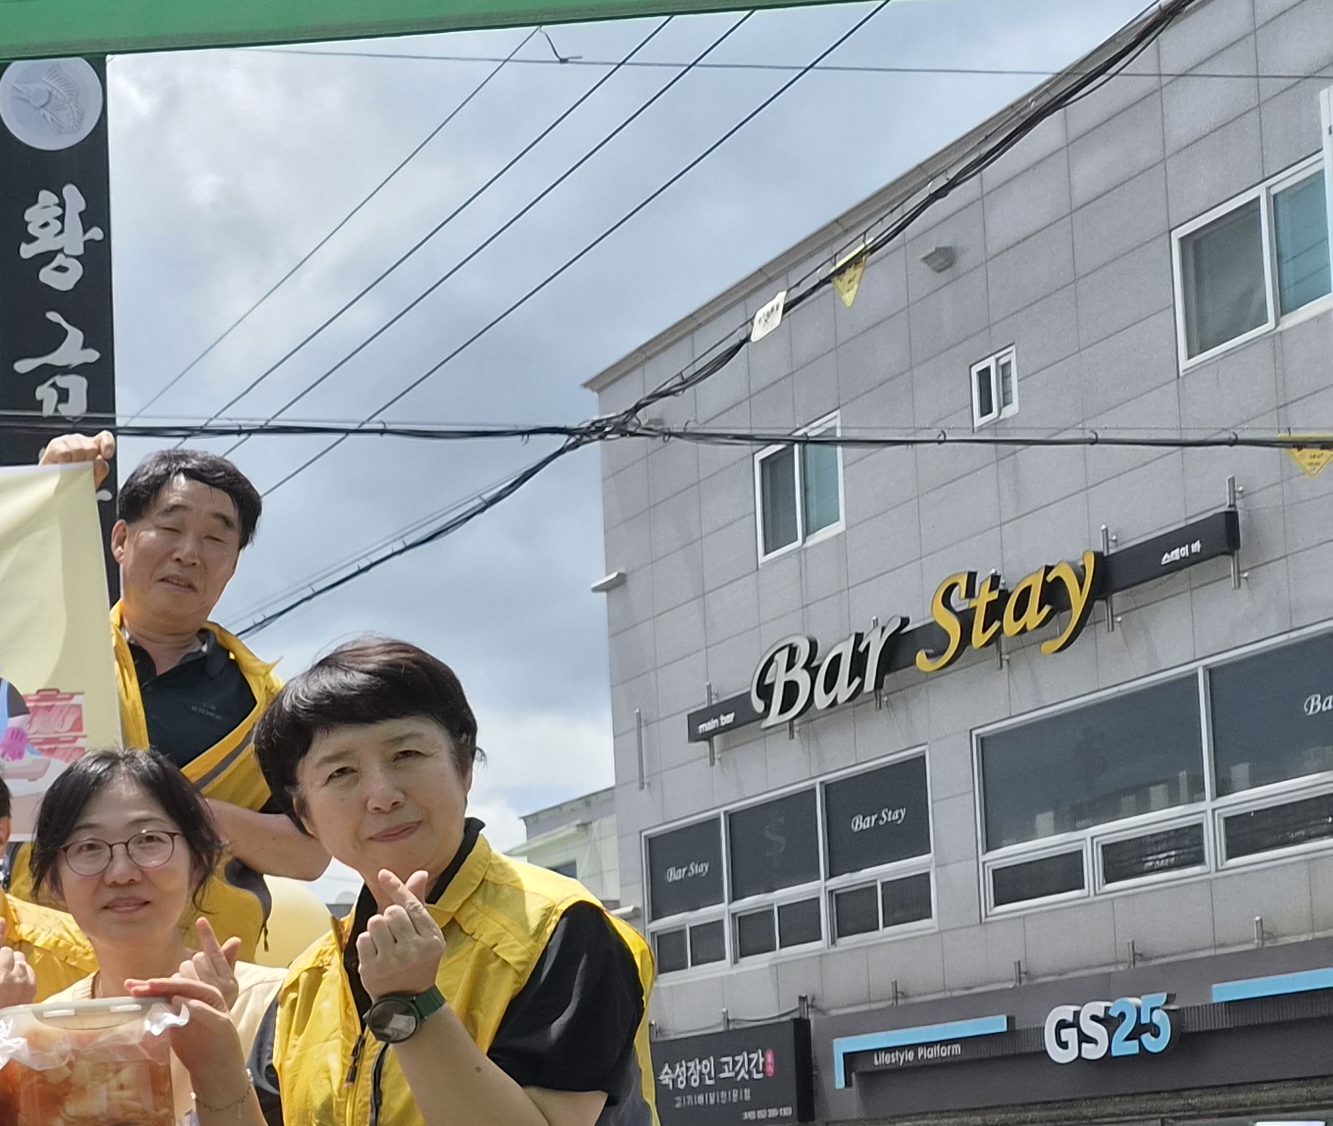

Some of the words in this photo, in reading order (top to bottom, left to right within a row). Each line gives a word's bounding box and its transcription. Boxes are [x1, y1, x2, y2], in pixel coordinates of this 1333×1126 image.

[751, 614, 908, 728] Bar
[916, 549, 1099, 671] Stay
[851, 813, 878, 832] Bar
[878, 805, 907, 825] Stay
[666, 866, 687, 882] Bar
[687, 860, 710, 877] Stay
[1044, 991, 1172, 1064] GS25
[658, 1055, 717, 1091] 숙성장인
[718, 1048, 766, 1082] 고깃간
[874, 1049, 914, 1067] Lifestyle
[917, 1042, 961, 1061] Platform
